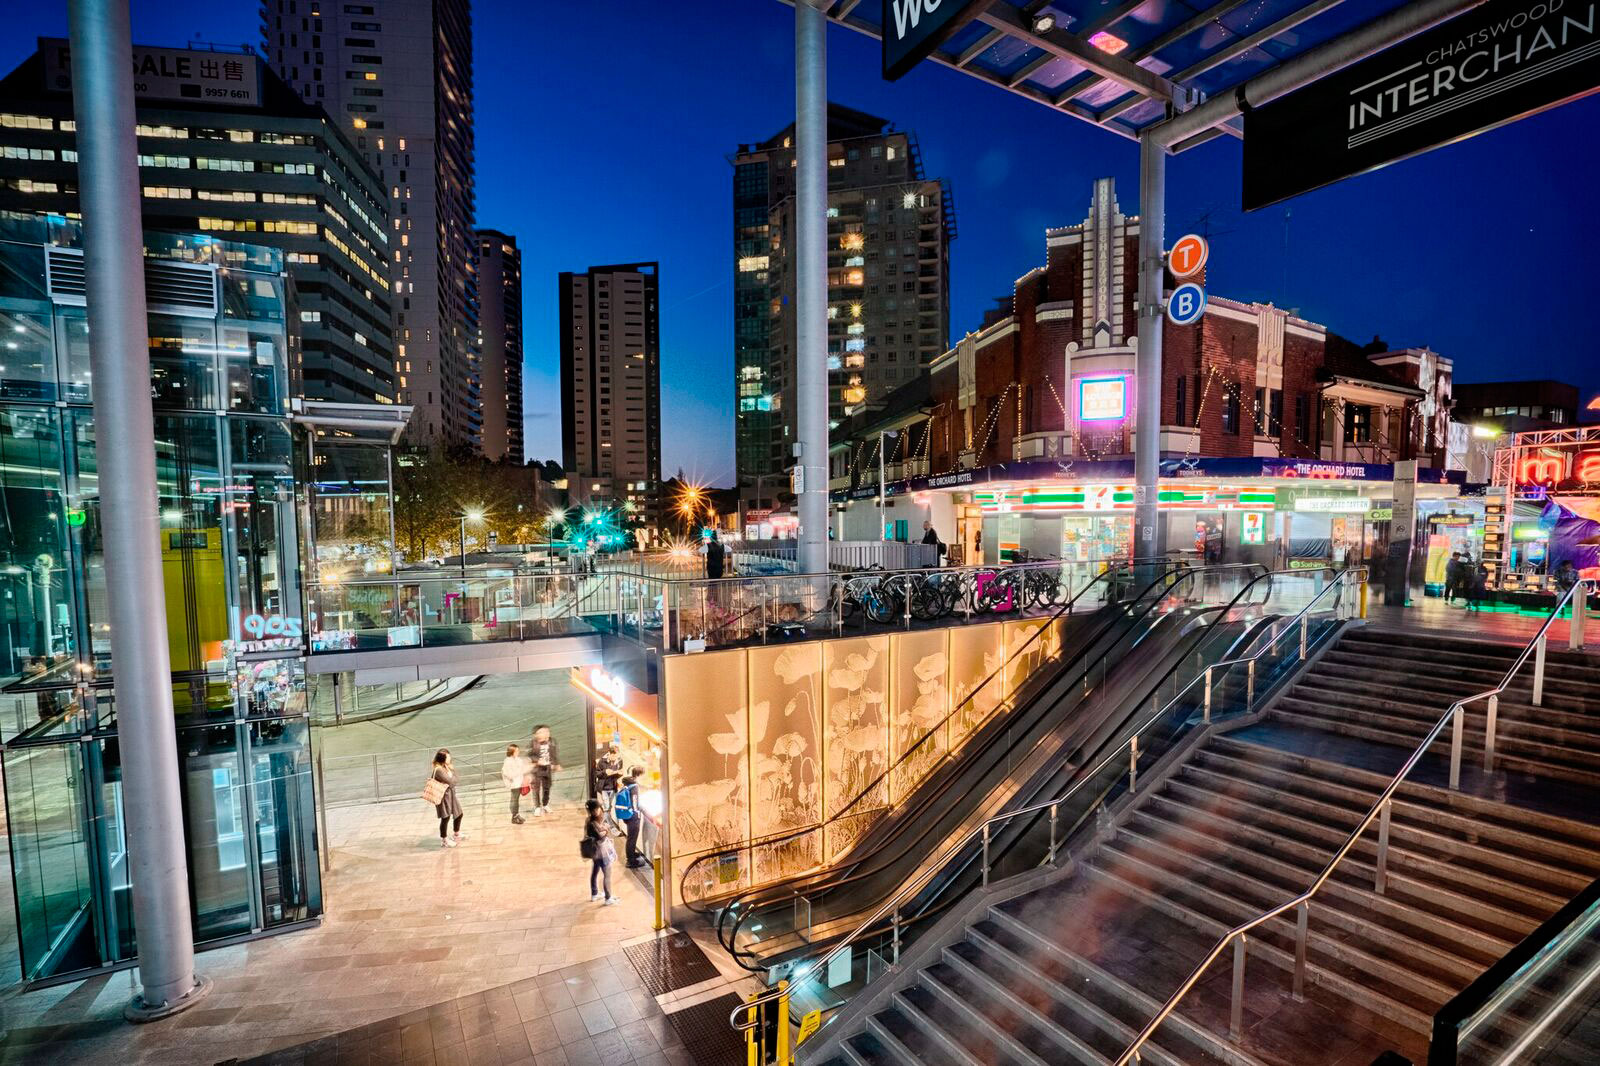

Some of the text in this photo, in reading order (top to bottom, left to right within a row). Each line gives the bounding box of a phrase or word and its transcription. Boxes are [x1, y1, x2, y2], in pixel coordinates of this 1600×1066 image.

[1426, 0, 1564, 65] CHATSWOOD
[200, 58, 243, 81] 出售
[1349, 3, 1594, 130] INTERCHAN
[205, 88, 250, 99] 9957 6611
[1179, 244, 1194, 269] T
[1178, 293, 1193, 317] B
[928, 473, 972, 487] THE ORCHARD HOTEL
[1297, 463, 1311, 474] THE
[1346, 466, 1366, 477] HOTEL
